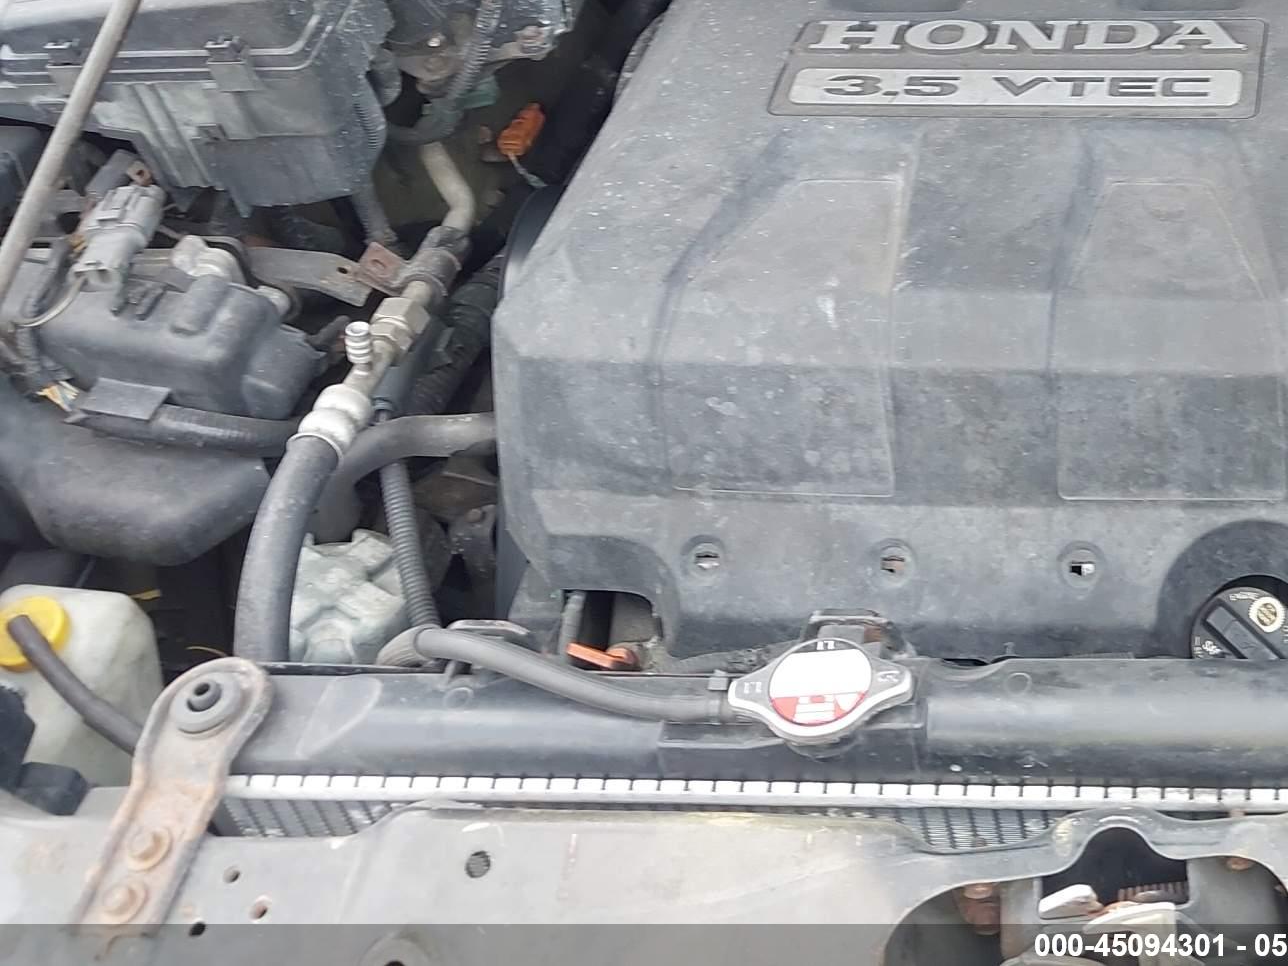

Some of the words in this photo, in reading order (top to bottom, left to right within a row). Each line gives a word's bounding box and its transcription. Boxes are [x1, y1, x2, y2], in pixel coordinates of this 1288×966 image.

[806, 19, 1250, 53] HONDA
[823, 75, 961, 97] 3.5
[991, 76, 1213, 97] VTEC
